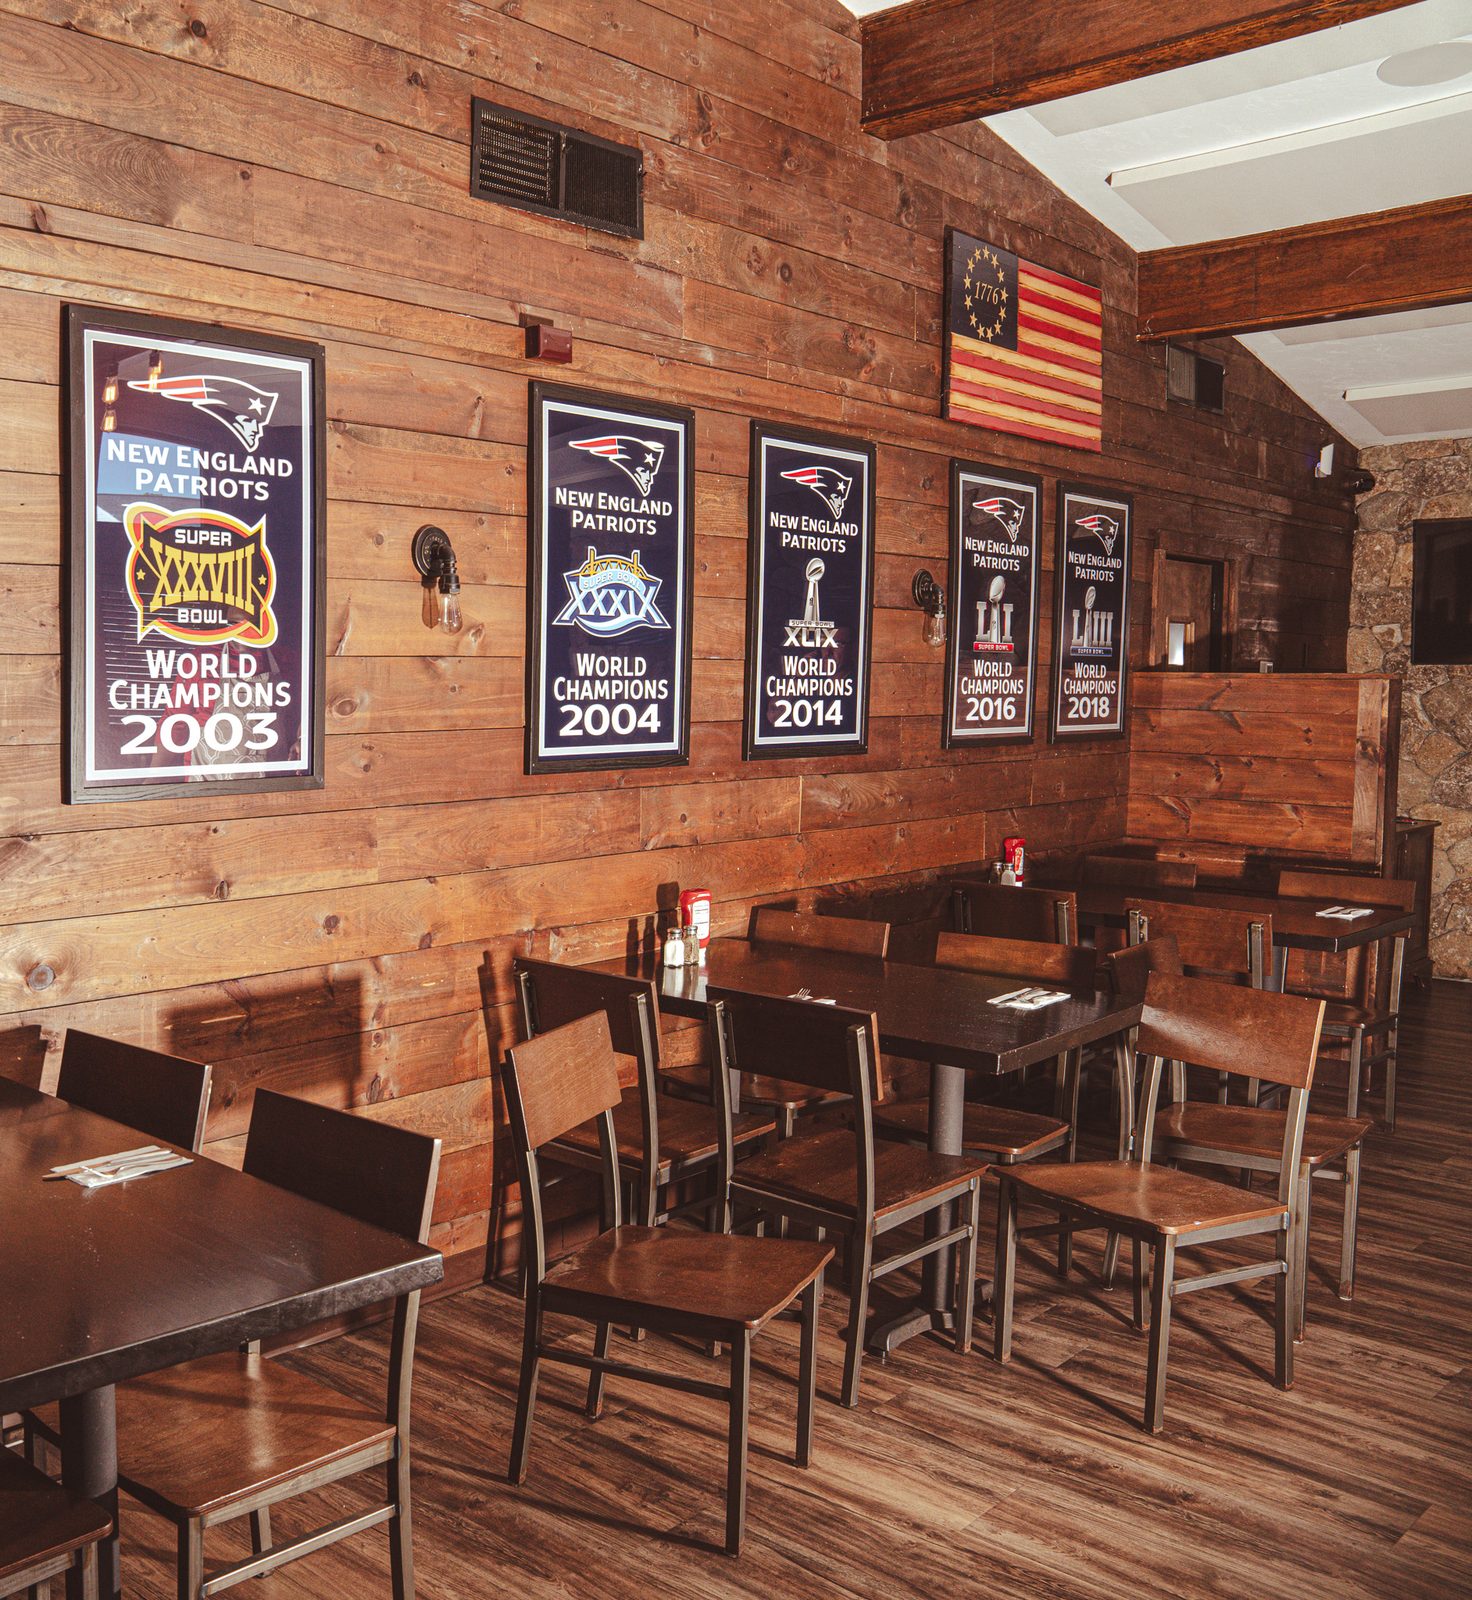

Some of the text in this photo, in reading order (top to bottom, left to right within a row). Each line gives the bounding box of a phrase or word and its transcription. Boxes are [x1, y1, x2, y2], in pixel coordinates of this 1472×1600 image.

[974, 280, 1000, 305] 1776
[107, 439, 293, 478] NEW ENGLAND
[135, 468, 270, 501] PATRIOTS
[555, 487, 673, 517] NEW ENGLAND
[572, 510, 657, 536] PATRIOTS
[770, 511, 859, 537] NEW ENGLAND
[174, 528, 232, 547] SUPER
[782, 531, 846, 553] PATRIOTS
[965, 536, 1030, 557] NEW ENGLAND
[973, 553, 1020, 572] PATRIOTS
[1068, 550, 1122, 569] NEW ENGLAND
[149, 536, 256, 616] XXXVIII
[583, 572, 613, 590] SUPER
[1075, 566, 1115, 582] PATRIOTS
[560, 581, 664, 624] XXXIX
[177, 608, 228, 624] BOWL
[975, 601, 1014, 642] LI
[1071, 609, 1114, 647] LIII
[783, 626, 839, 648] XLIX
[146, 649, 258, 679] WORLD
[576, 653, 647, 677] WORLD
[783, 655, 837, 676] WORLD
[973, 659, 1012, 678] WORLD
[1074, 662, 1107, 679] WORLD
[109, 679, 292, 710] CHAMPIONS
[553, 676, 669, 701] CHAMPIONS
[766, 675, 853, 697] CHAMPIONS
[961, 676, 1024, 695] CHAMPIONS
[1063, 678, 1117, 695] CHAMPIONS
[559, 702, 661, 737] 2004
[774, 699, 843, 728] 2014
[966, 696, 1016, 721] 2016
[1067, 696, 1110, 719] 2018
[120, 712, 279, 755] 2003
